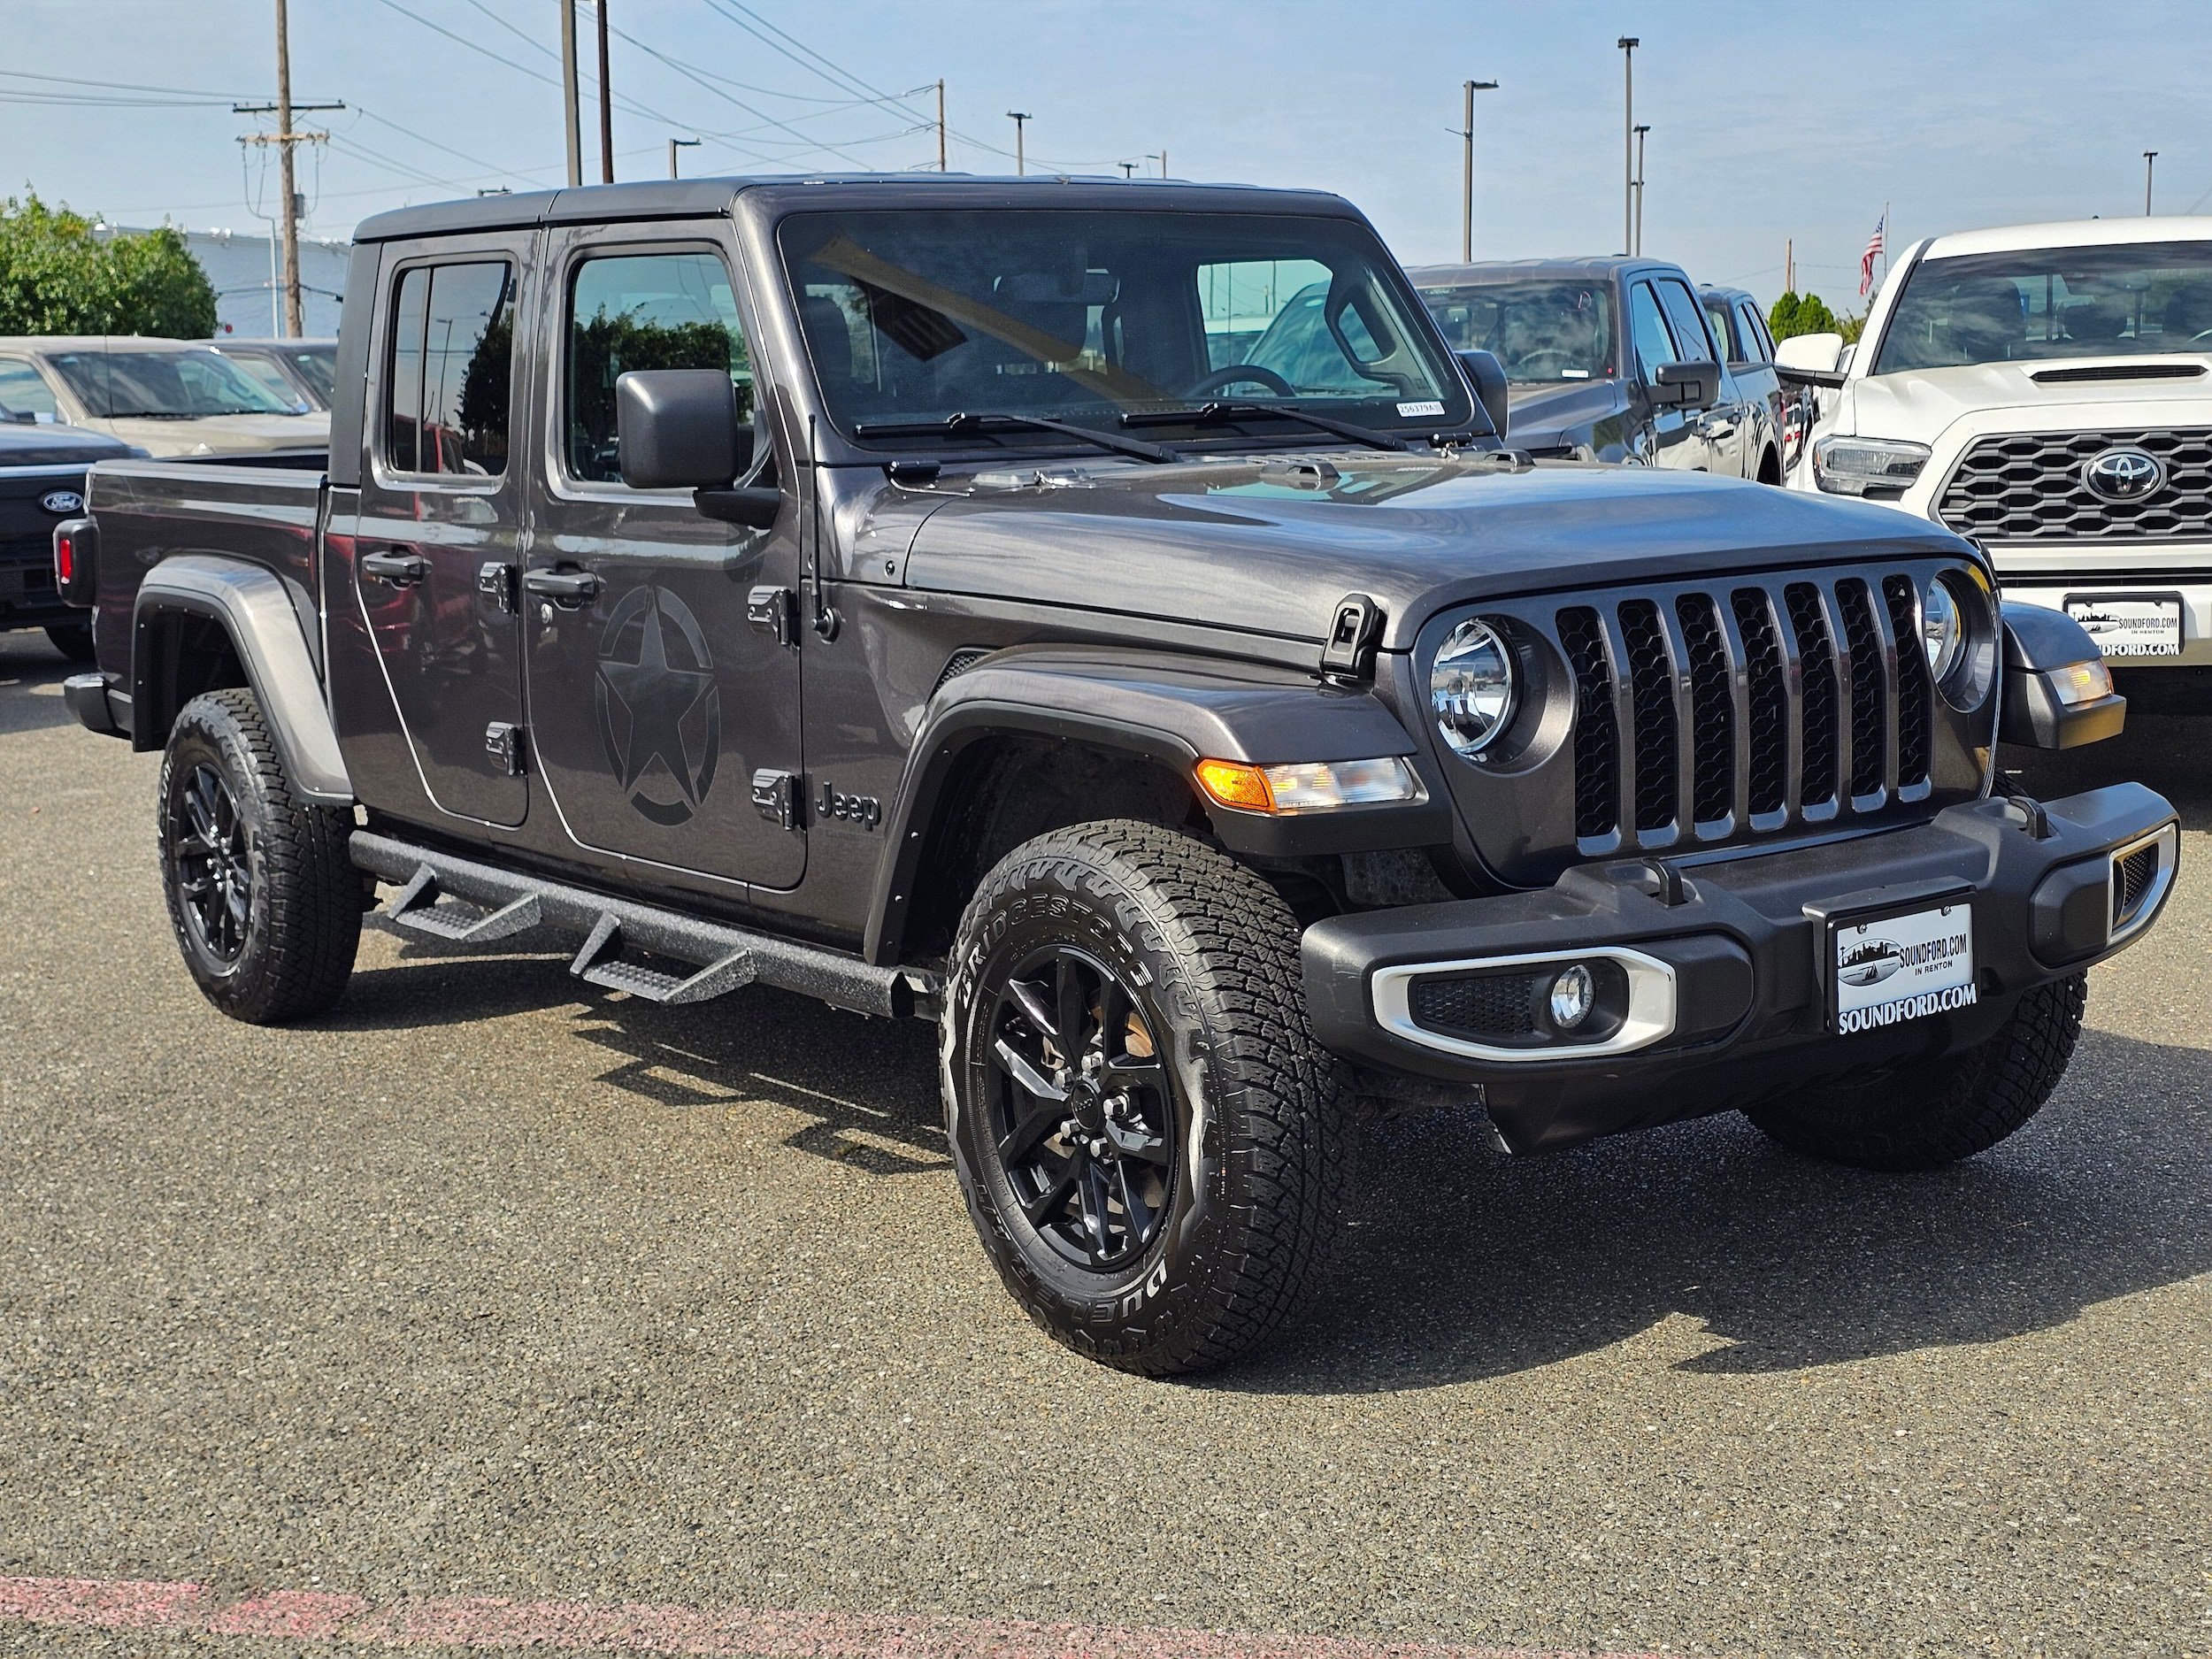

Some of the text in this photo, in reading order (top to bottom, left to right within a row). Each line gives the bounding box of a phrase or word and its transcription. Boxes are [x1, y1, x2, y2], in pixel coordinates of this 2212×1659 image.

[2118, 617, 2177, 629] SOUNDFORD.COM
[2099, 643, 2179, 657] DFORD.COM
[814, 781, 881, 832] Jeep
[957, 893, 1154, 1010] BRIDGESTONE
[1900, 933, 1967, 968] SOUNDFORD.COM
[1915, 960, 1953, 976] IN RENTON
[1839, 983, 1977, 1034] SOUNDFORD.COM
[1010, 1251, 1168, 1324] DUELER
